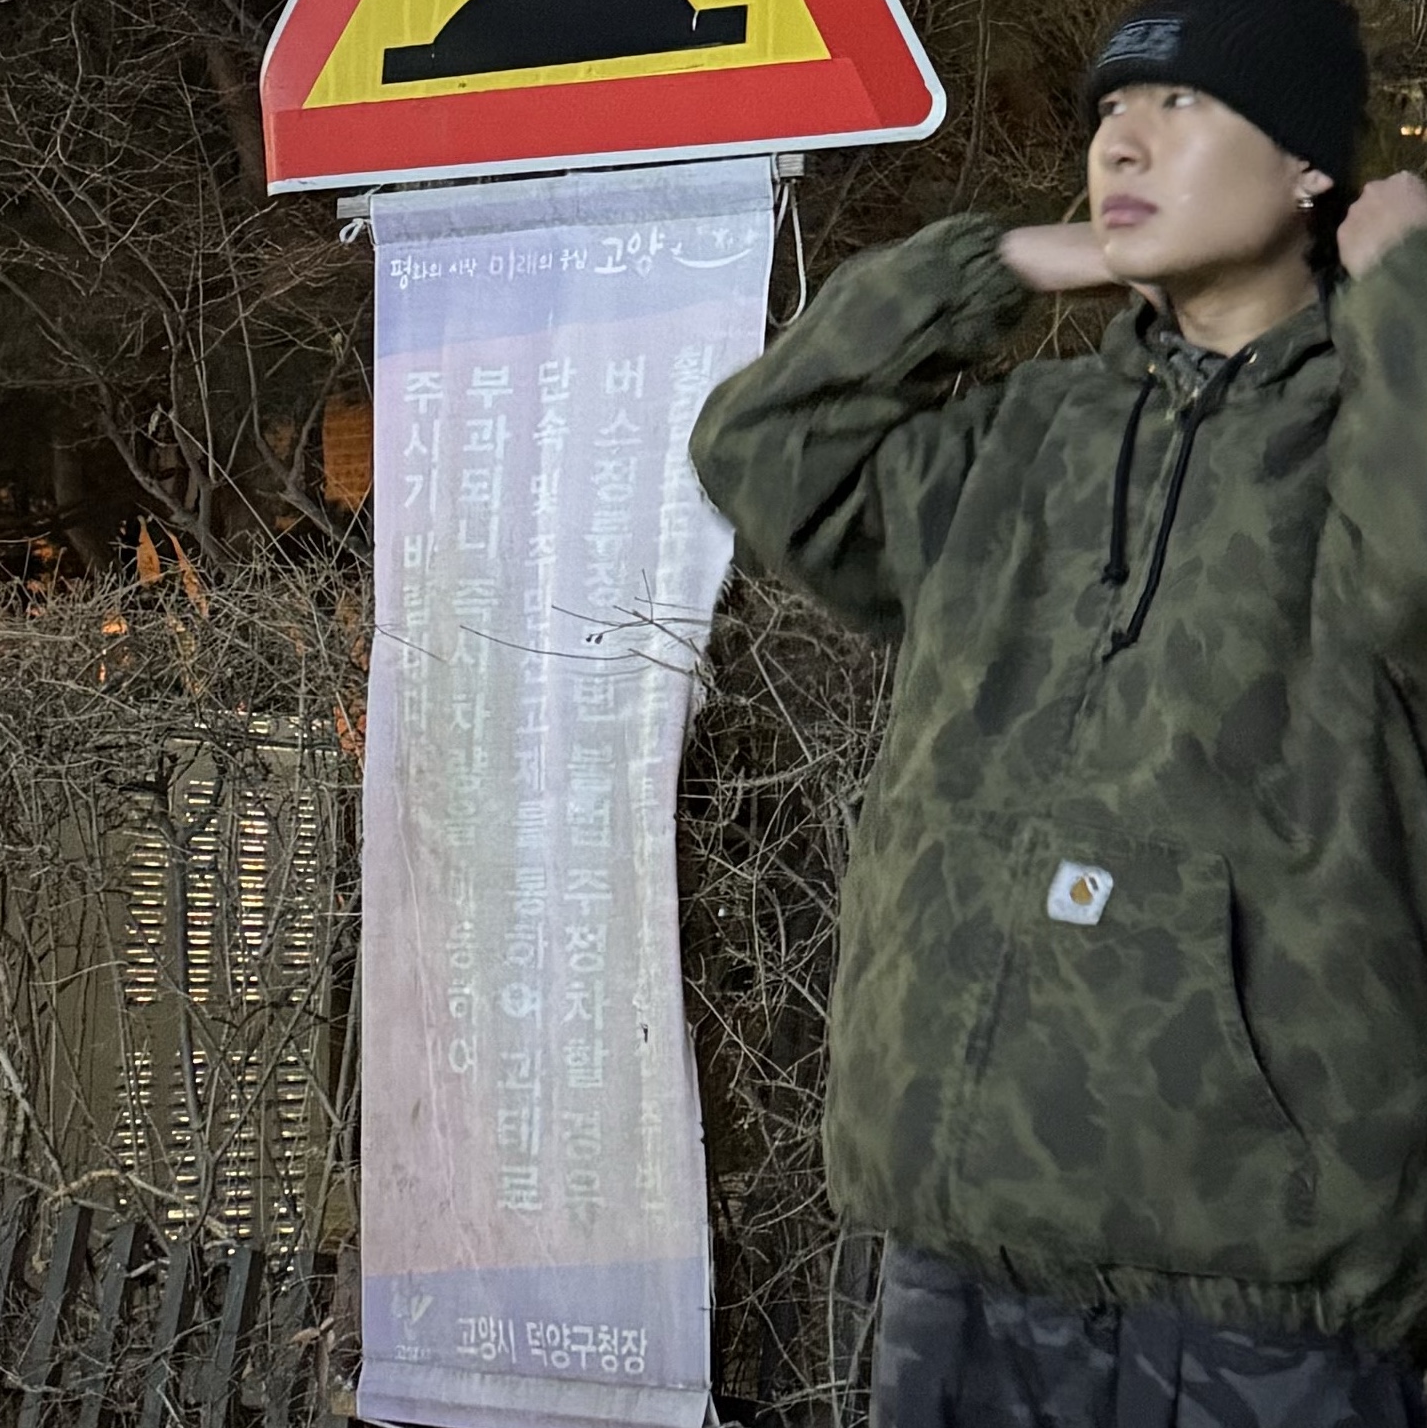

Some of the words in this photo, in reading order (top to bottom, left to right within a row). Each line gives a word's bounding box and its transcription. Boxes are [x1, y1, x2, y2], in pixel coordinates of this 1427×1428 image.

[389, 255, 441, 290] 평화의
[489, 248, 552, 282] 미래의
[594, 227, 666, 278] 고양
[403, 371, 444, 514] 주시기
[455, 365, 513, 560] 부과되니
[532, 356, 577, 450] 단속
[583, 355, 646, 606] 버스정류장
[449, 578, 499, 673] 즉시
[511, 534, 558, 848] 주민신고제를
[567, 744, 614, 847] 불법
[502, 867, 548, 1028] 통하여
[564, 868, 612, 1089] 주정차할
[497, 1049, 543, 1211] 과태료
[456, 1315, 516, 1365] 고양시
[525, 1320, 648, 1375] 덕양구청장
